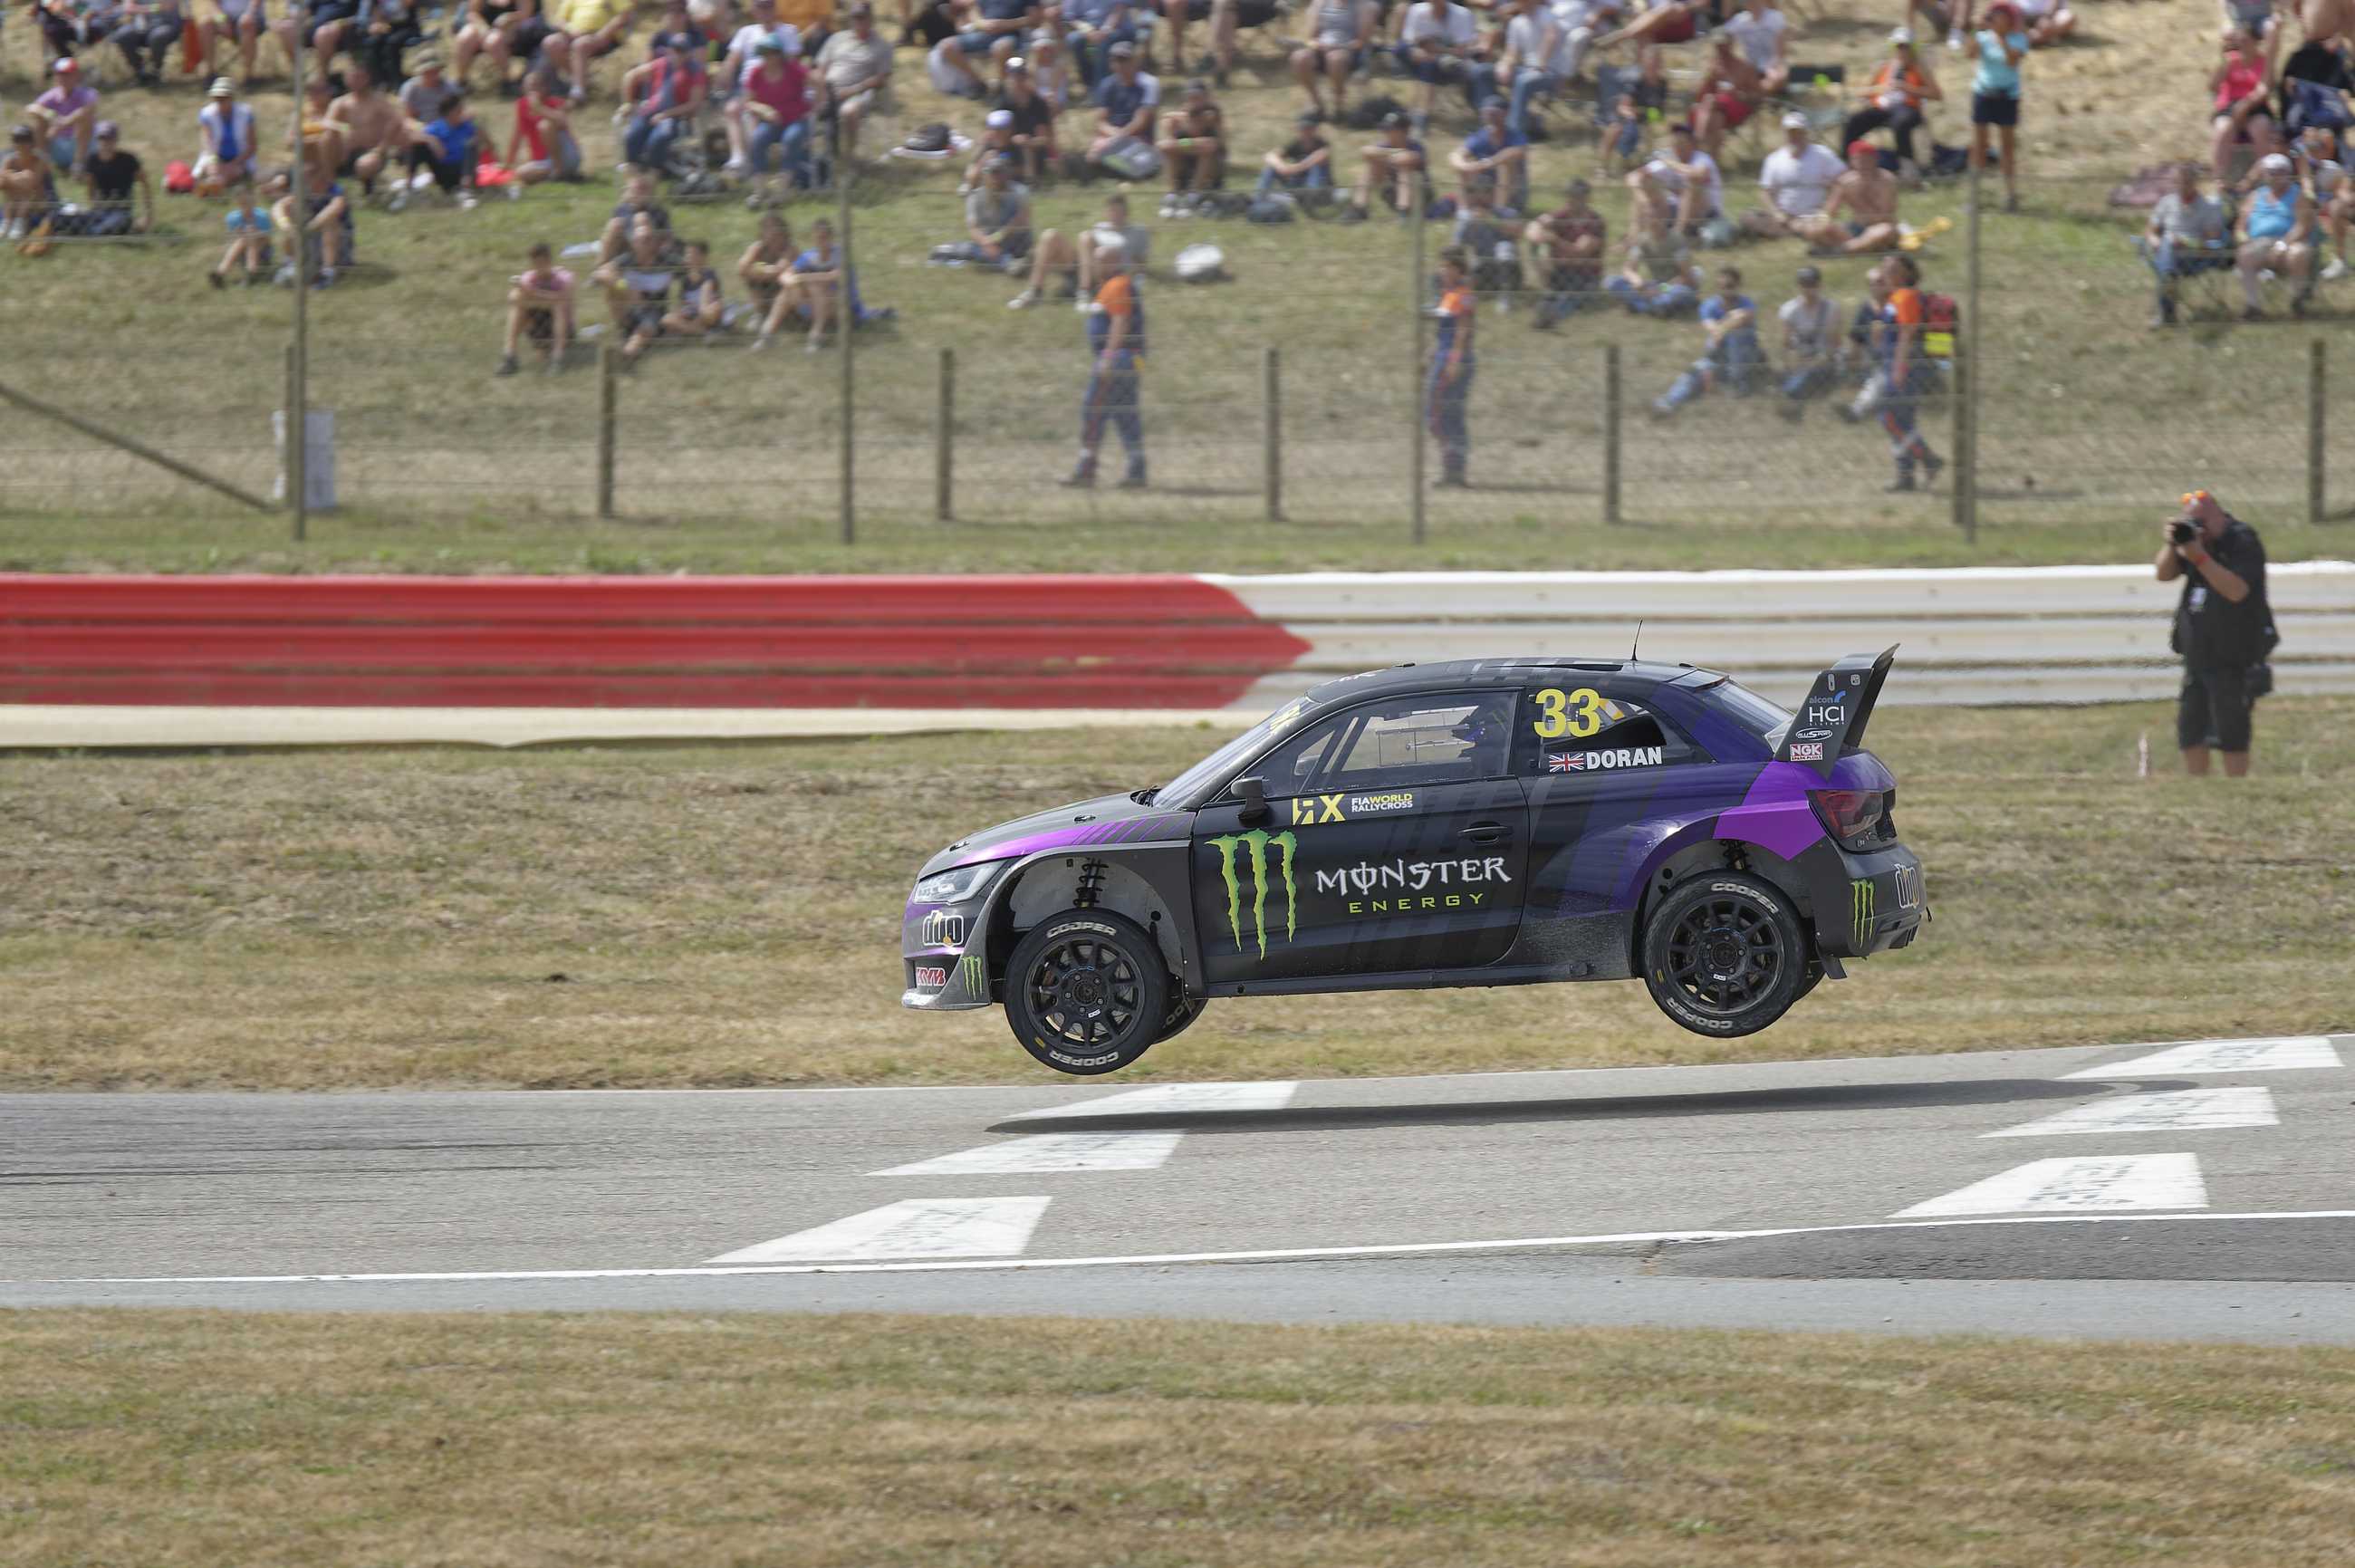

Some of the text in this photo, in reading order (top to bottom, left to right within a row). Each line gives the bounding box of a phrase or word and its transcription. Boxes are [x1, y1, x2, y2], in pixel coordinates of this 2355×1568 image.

[1809, 695, 1833, 704] alcon
[1533, 688, 1601, 738] 33
[1809, 706, 1844, 722] HCI
[1586, 746, 1663, 770] DORAN
[1791, 744, 1821, 755] NGK
[1351, 800, 1413, 813] RALLYCROSS
[1315, 857, 1513, 895] MONSTER
[1348, 892, 1485, 914] ENERGY
[1710, 882, 1780, 915] COOPER
[1046, 921, 1117, 938] COOPER
[1665, 996, 1734, 1029] COOPER
[1049, 1050, 1120, 1067] COOPER
